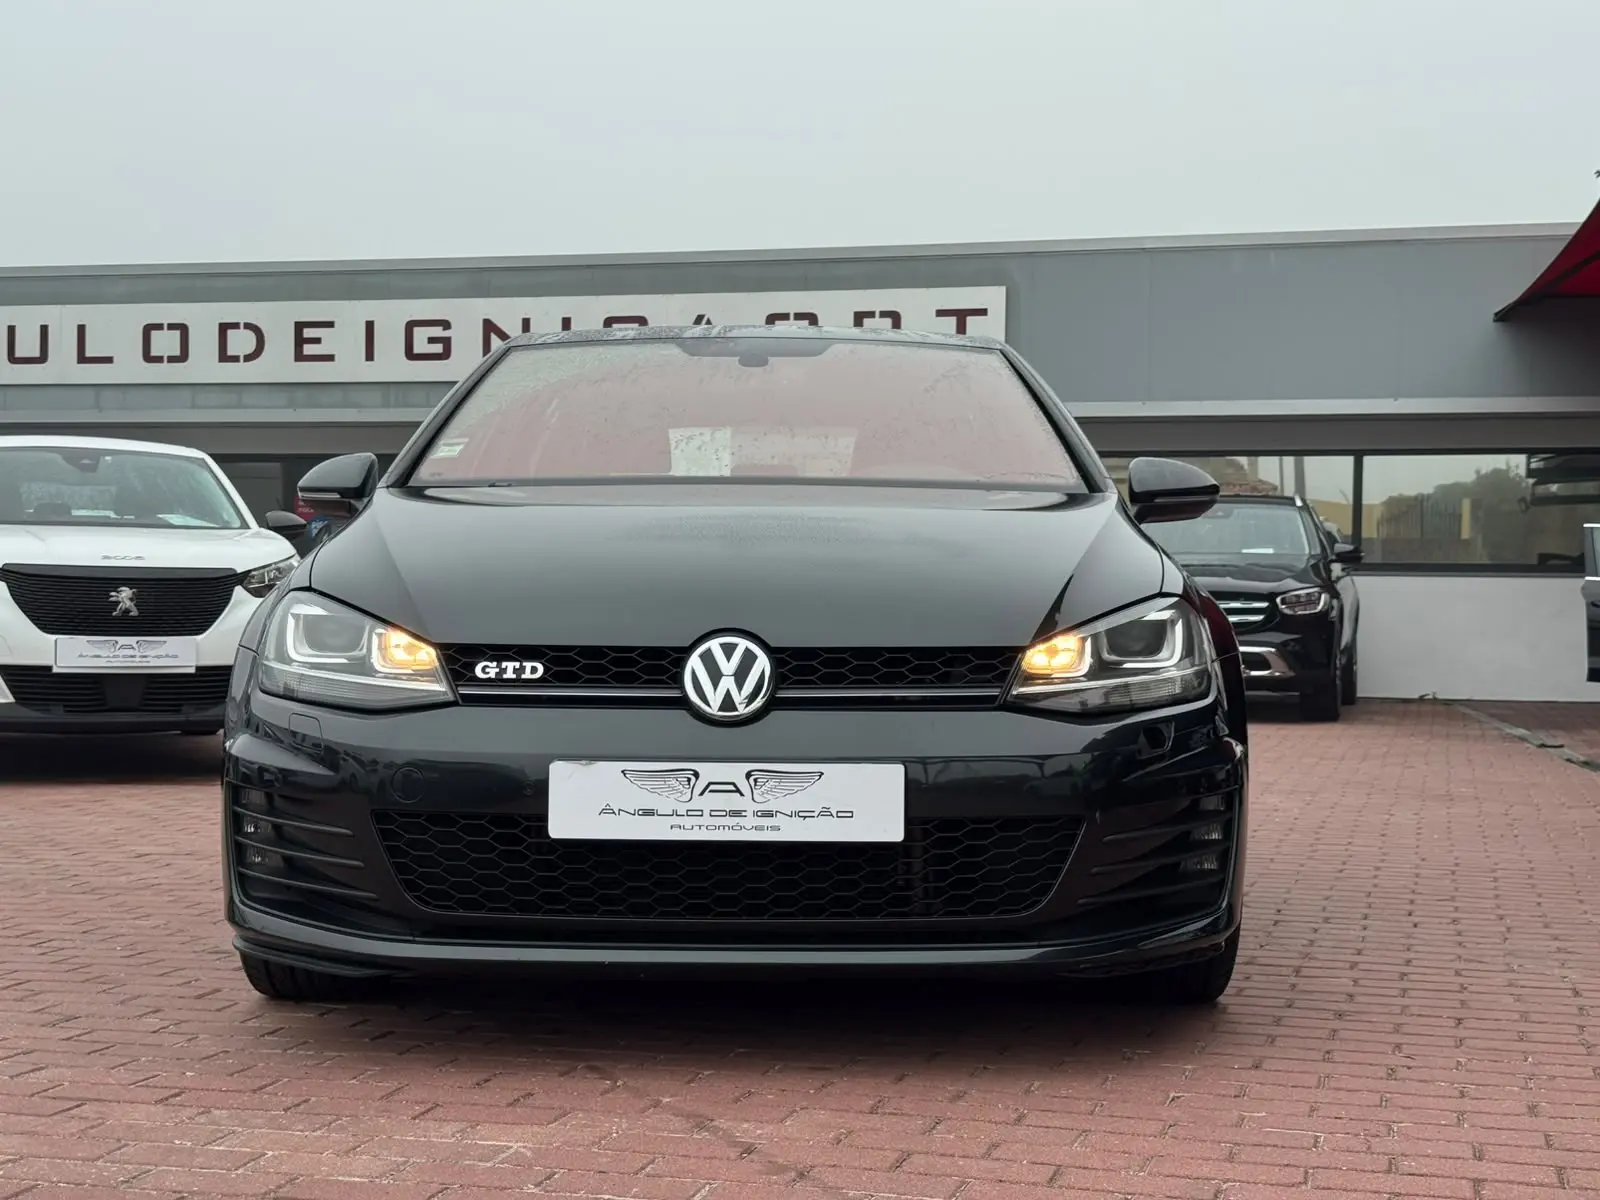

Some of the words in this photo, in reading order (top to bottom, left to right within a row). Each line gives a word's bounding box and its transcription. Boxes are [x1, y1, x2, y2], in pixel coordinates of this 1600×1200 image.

[474, 661, 544, 680] GTD
[698, 781, 745, 797] A
[598, 803, 705, 818] ÂNGULO
[709, 809, 748, 818] DE
[752, 806, 854, 821] IGNIÇÃO
